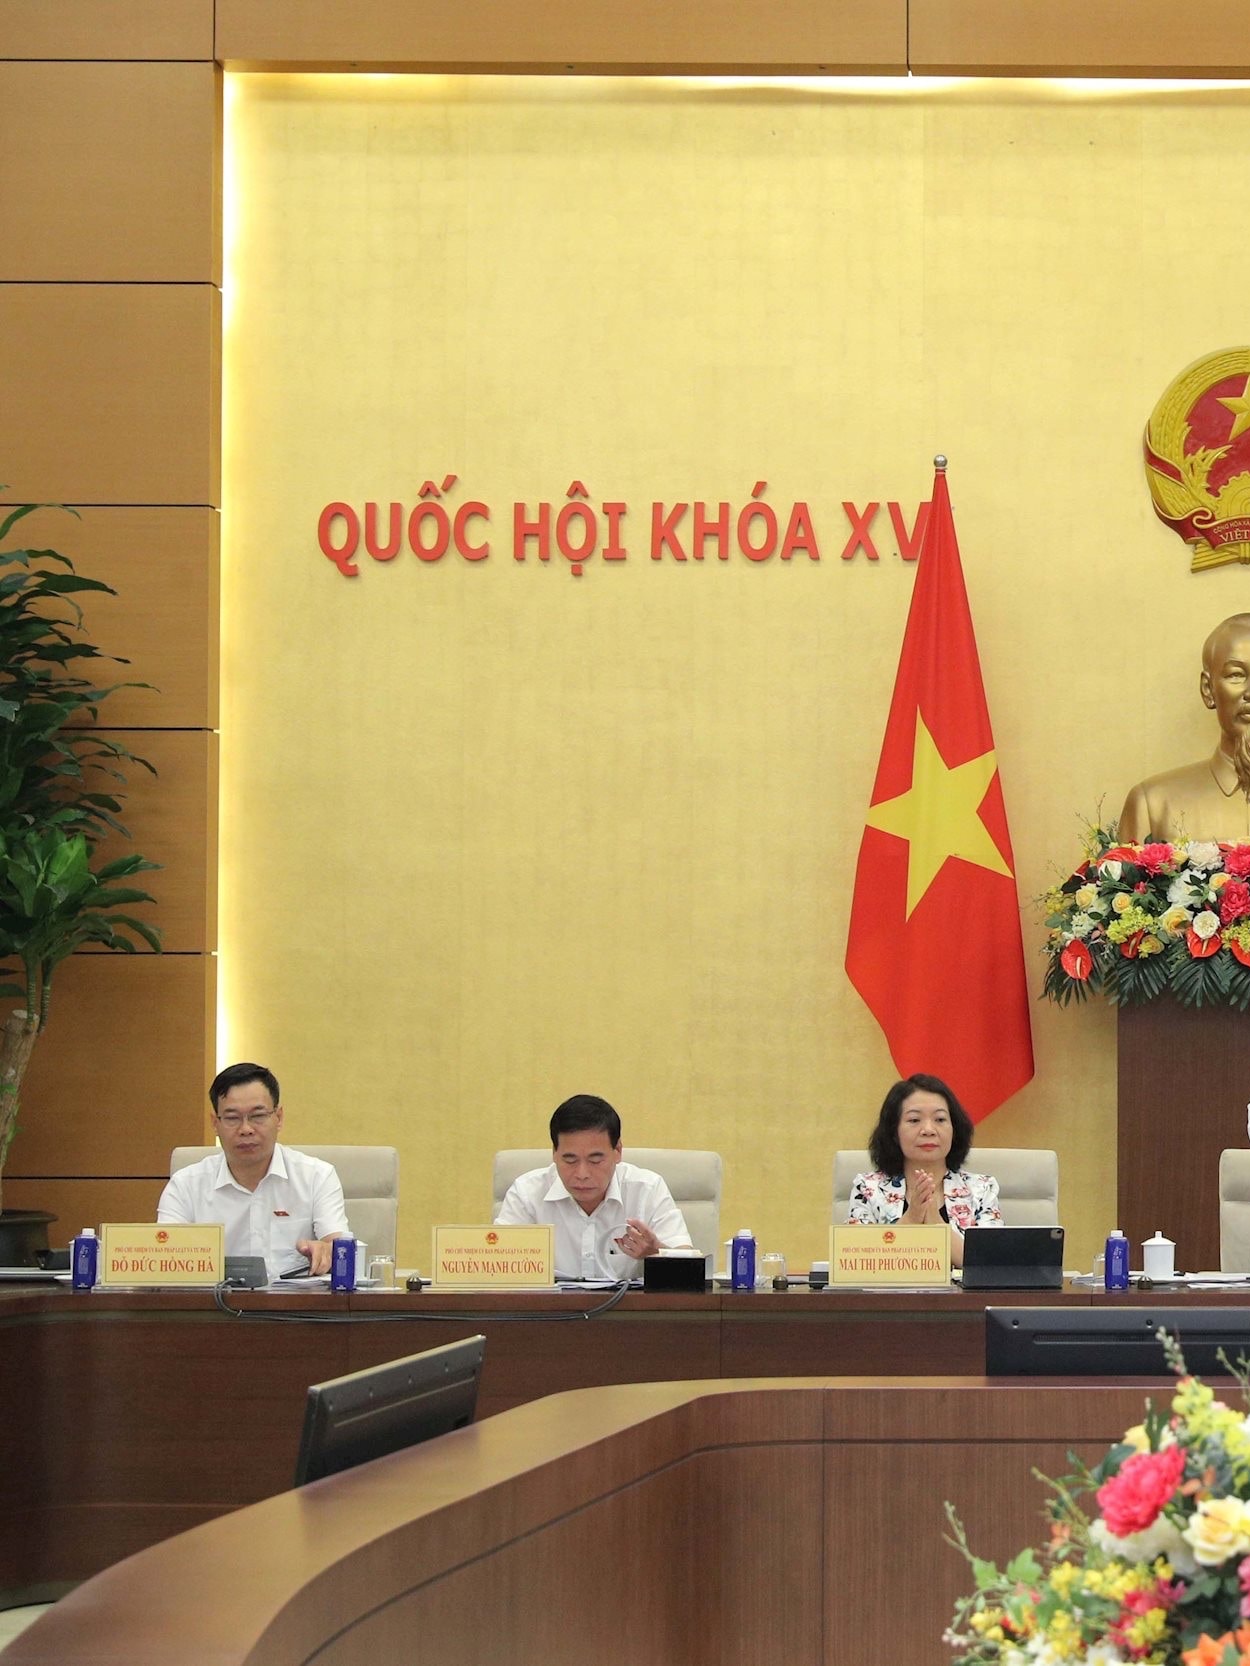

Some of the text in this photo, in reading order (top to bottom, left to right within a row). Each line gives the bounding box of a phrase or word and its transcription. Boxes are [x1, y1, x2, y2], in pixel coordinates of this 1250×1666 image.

[317, 474, 932, 577] QUỐC HỘI KHÓA XV
[131, 1256, 157, 1272] ĐỨC
[197, 1256, 214, 1272] HÀ
[482, 1261, 509, 1276] MẠNH
[511, 1257, 544, 1273] CƯỜNG
[839, 1257, 941, 1274] MAI THỊ PHƯƠNG HOA
